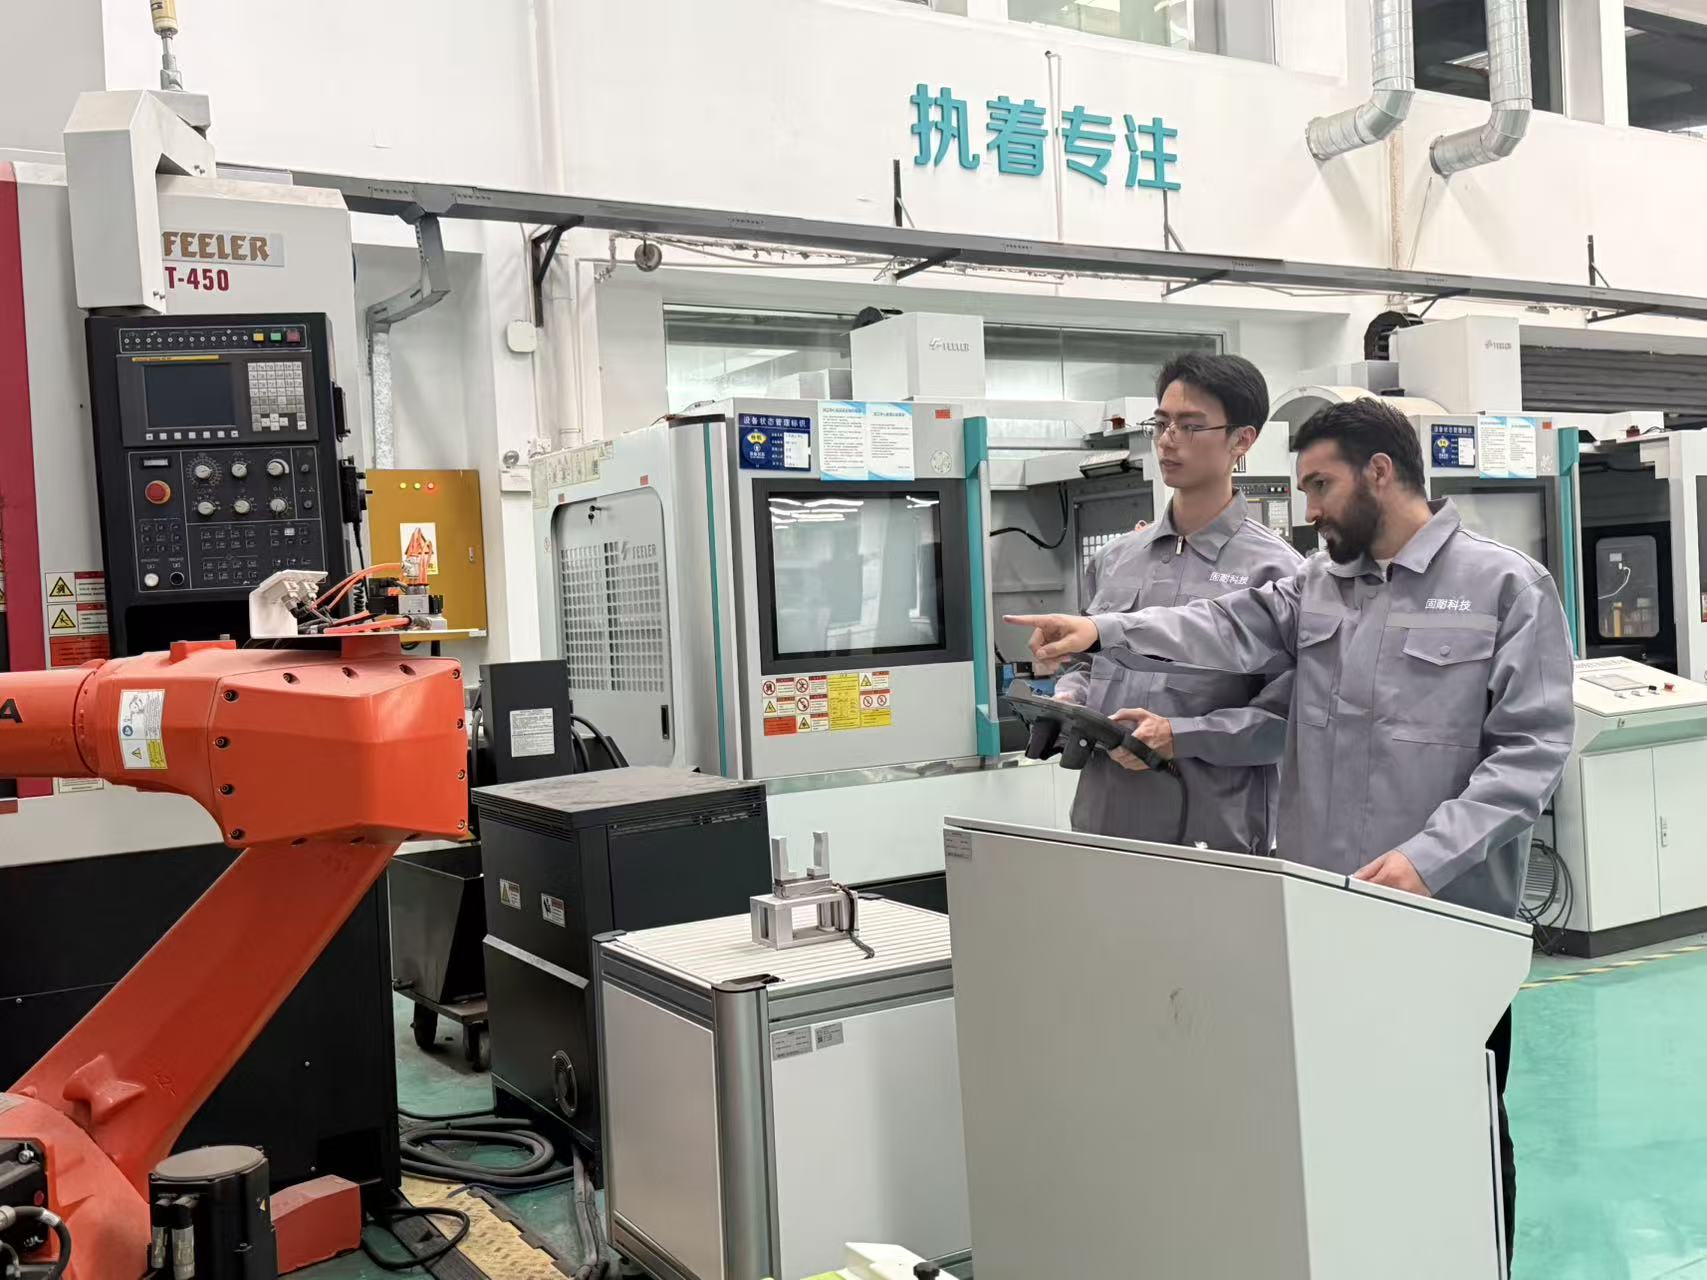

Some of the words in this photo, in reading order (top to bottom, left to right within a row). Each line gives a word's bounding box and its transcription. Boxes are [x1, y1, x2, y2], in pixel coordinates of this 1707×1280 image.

[910, 83, 1181, 190] 执着专注
[161, 231, 270, 262] FEELER
[164, 266, 230, 291] T-450
